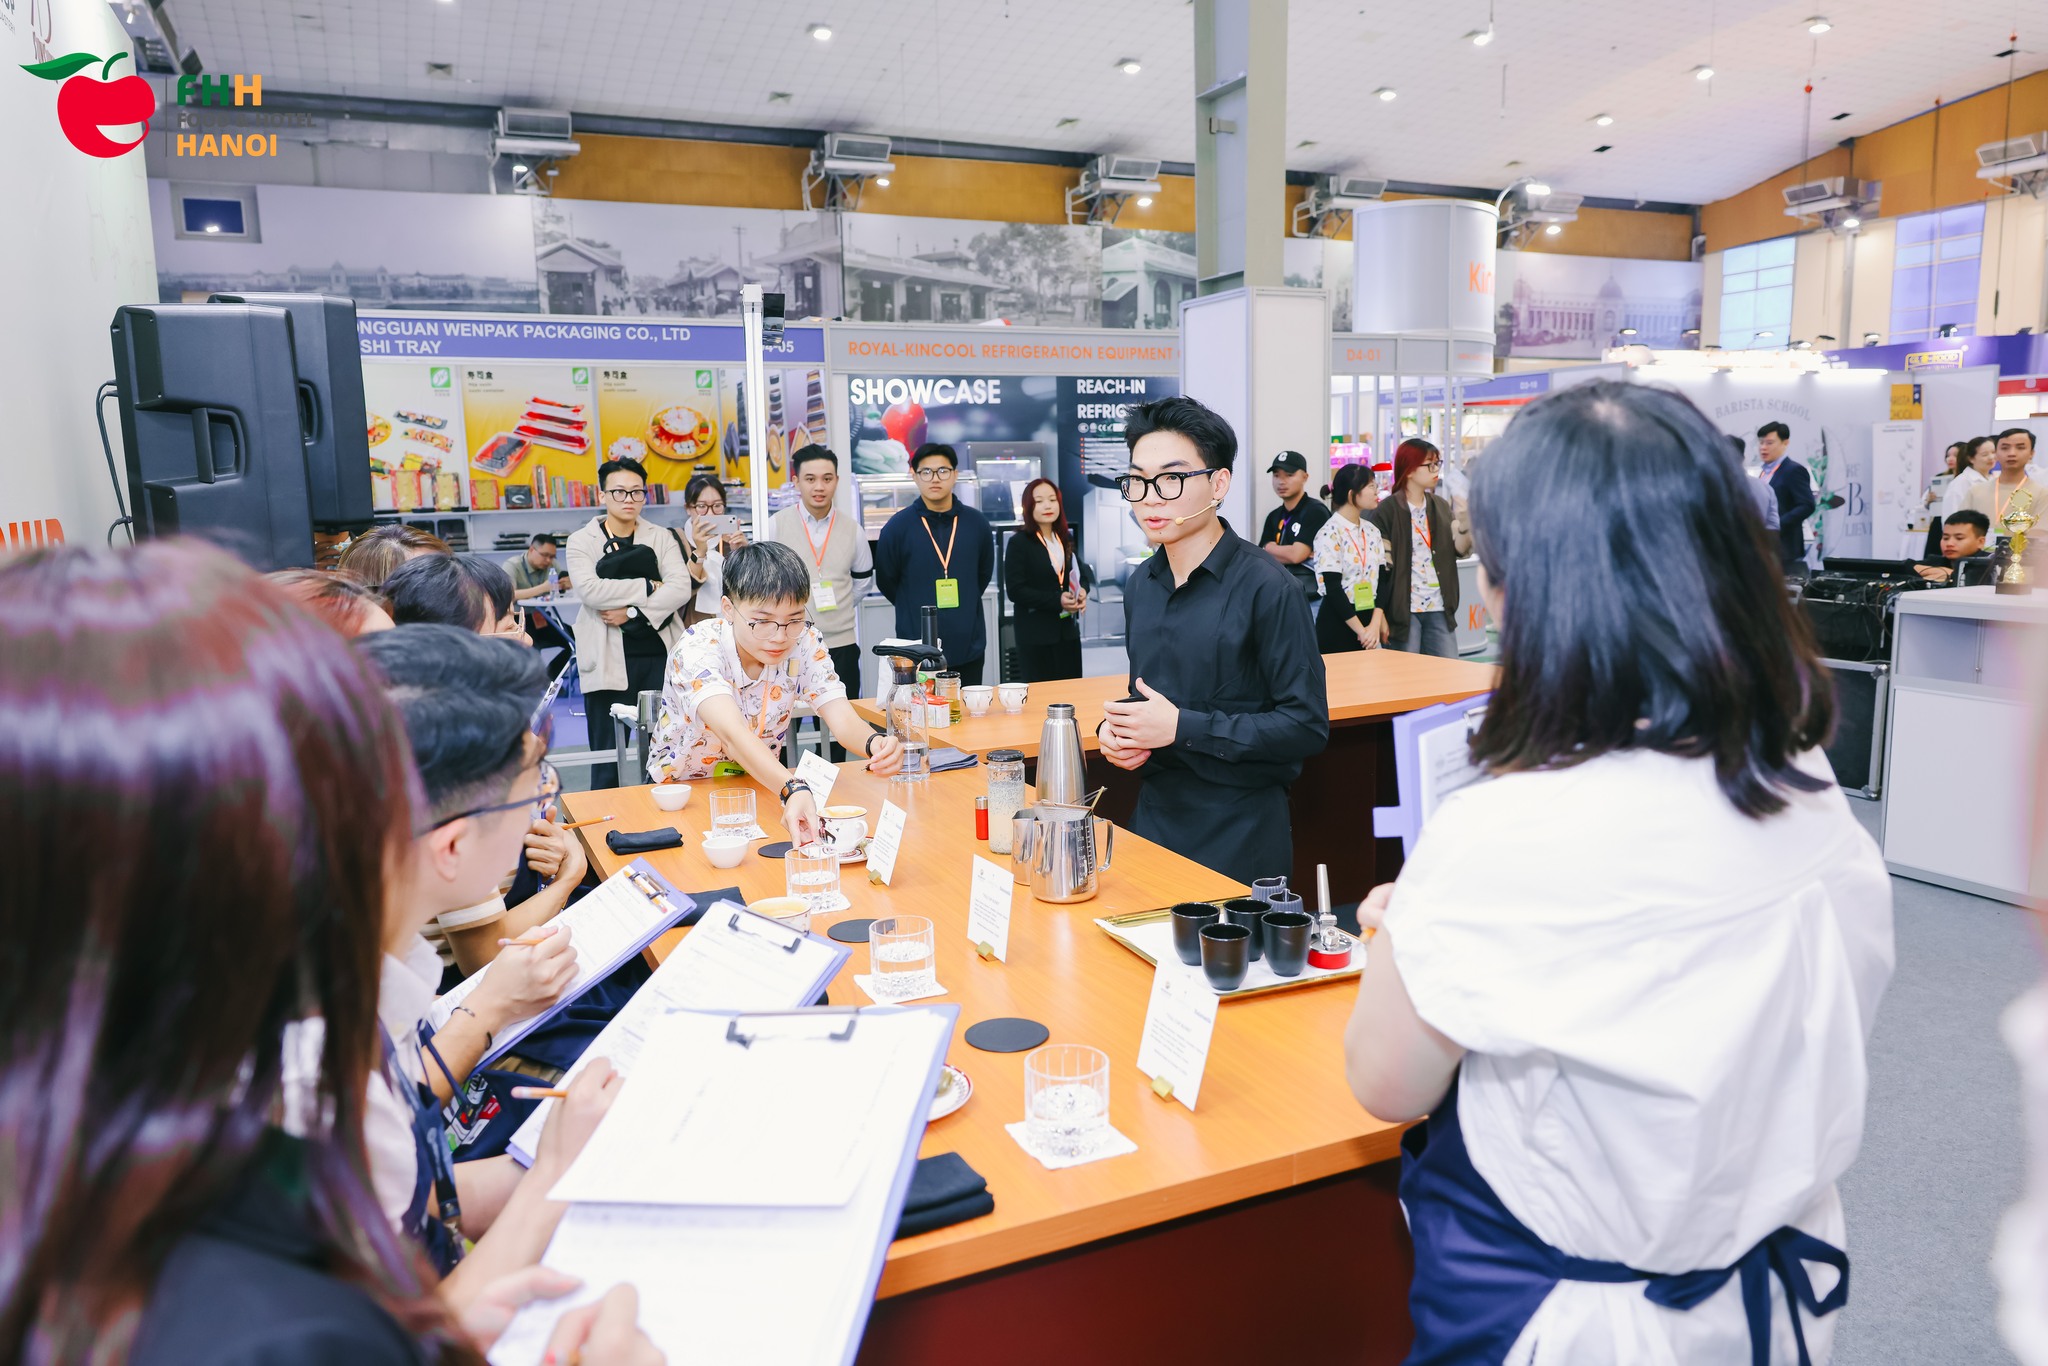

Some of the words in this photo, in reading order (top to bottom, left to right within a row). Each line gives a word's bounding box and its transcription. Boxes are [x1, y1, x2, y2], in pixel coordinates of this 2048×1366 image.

[357, 320, 439, 336] NGGUAN
[443, 322, 519, 338] WENPAK
[523, 324, 622, 340] PACKAGING
[625, 327, 658, 343] CO.,
[662, 327, 691, 341] LTD
[394, 340, 442, 354] TRAY
[848, 341, 976, 358] ROYAL-KINCOOL
[982, 344, 1092, 359] REFRIGERATION
[1098, 346, 1174, 360] EQUIPMENT
[850, 378, 1001, 405] SHOWCASE
[1076, 379, 1146, 394] REACH-IN
[1714, 398, 1764, 419] BARISTA
[1766, 398, 1810, 421] SCHOOL
